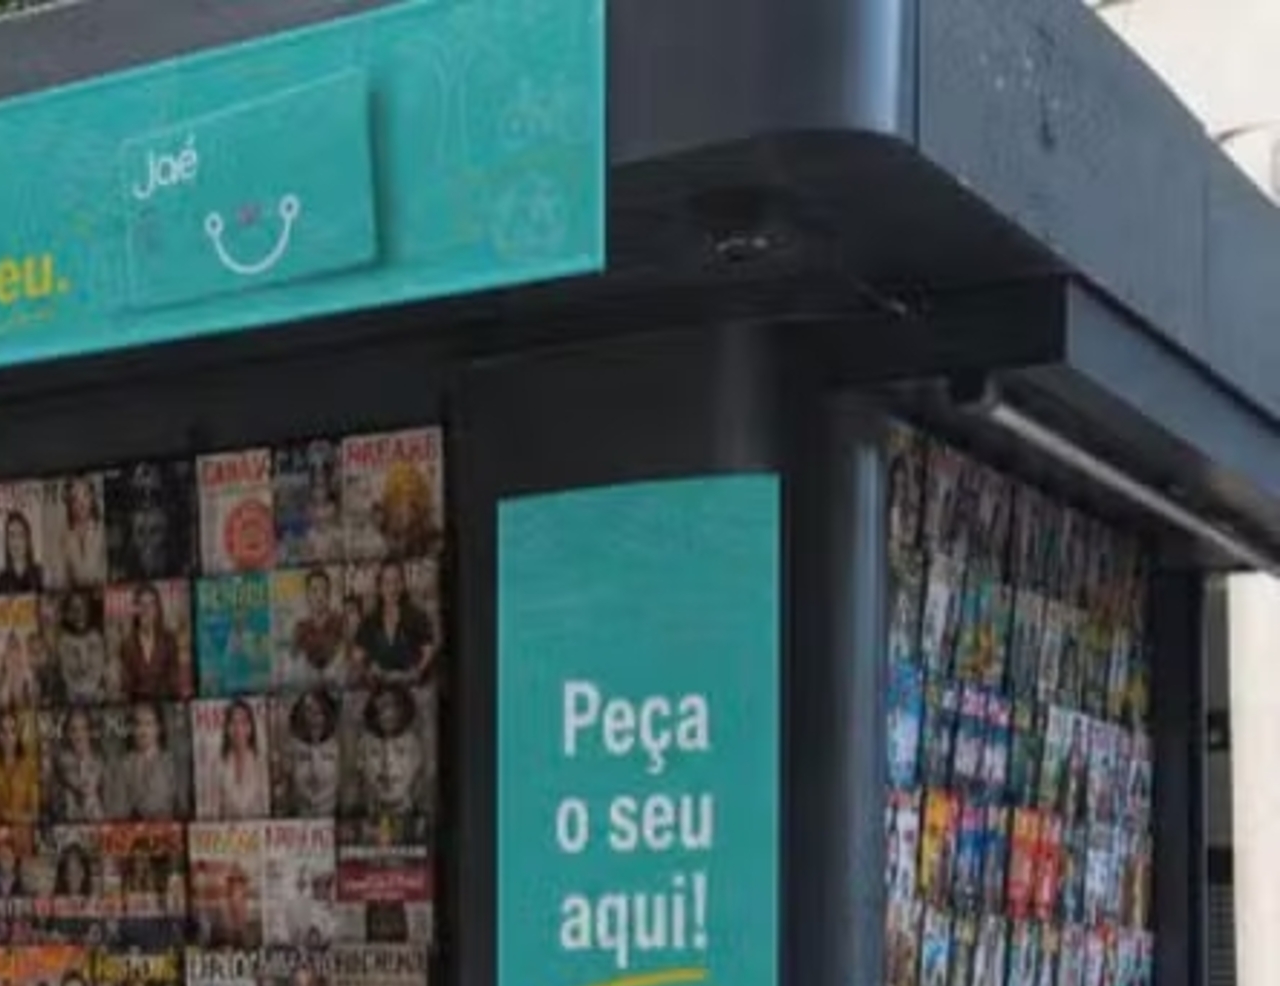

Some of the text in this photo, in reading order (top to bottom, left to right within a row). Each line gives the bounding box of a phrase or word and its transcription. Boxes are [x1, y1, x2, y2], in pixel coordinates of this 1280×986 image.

[132, 132, 198, 199] Jaé
[563, 680, 710, 775] Peça
[555, 794, 713, 853] o seu
[560, 871, 709, 969] aqui!
